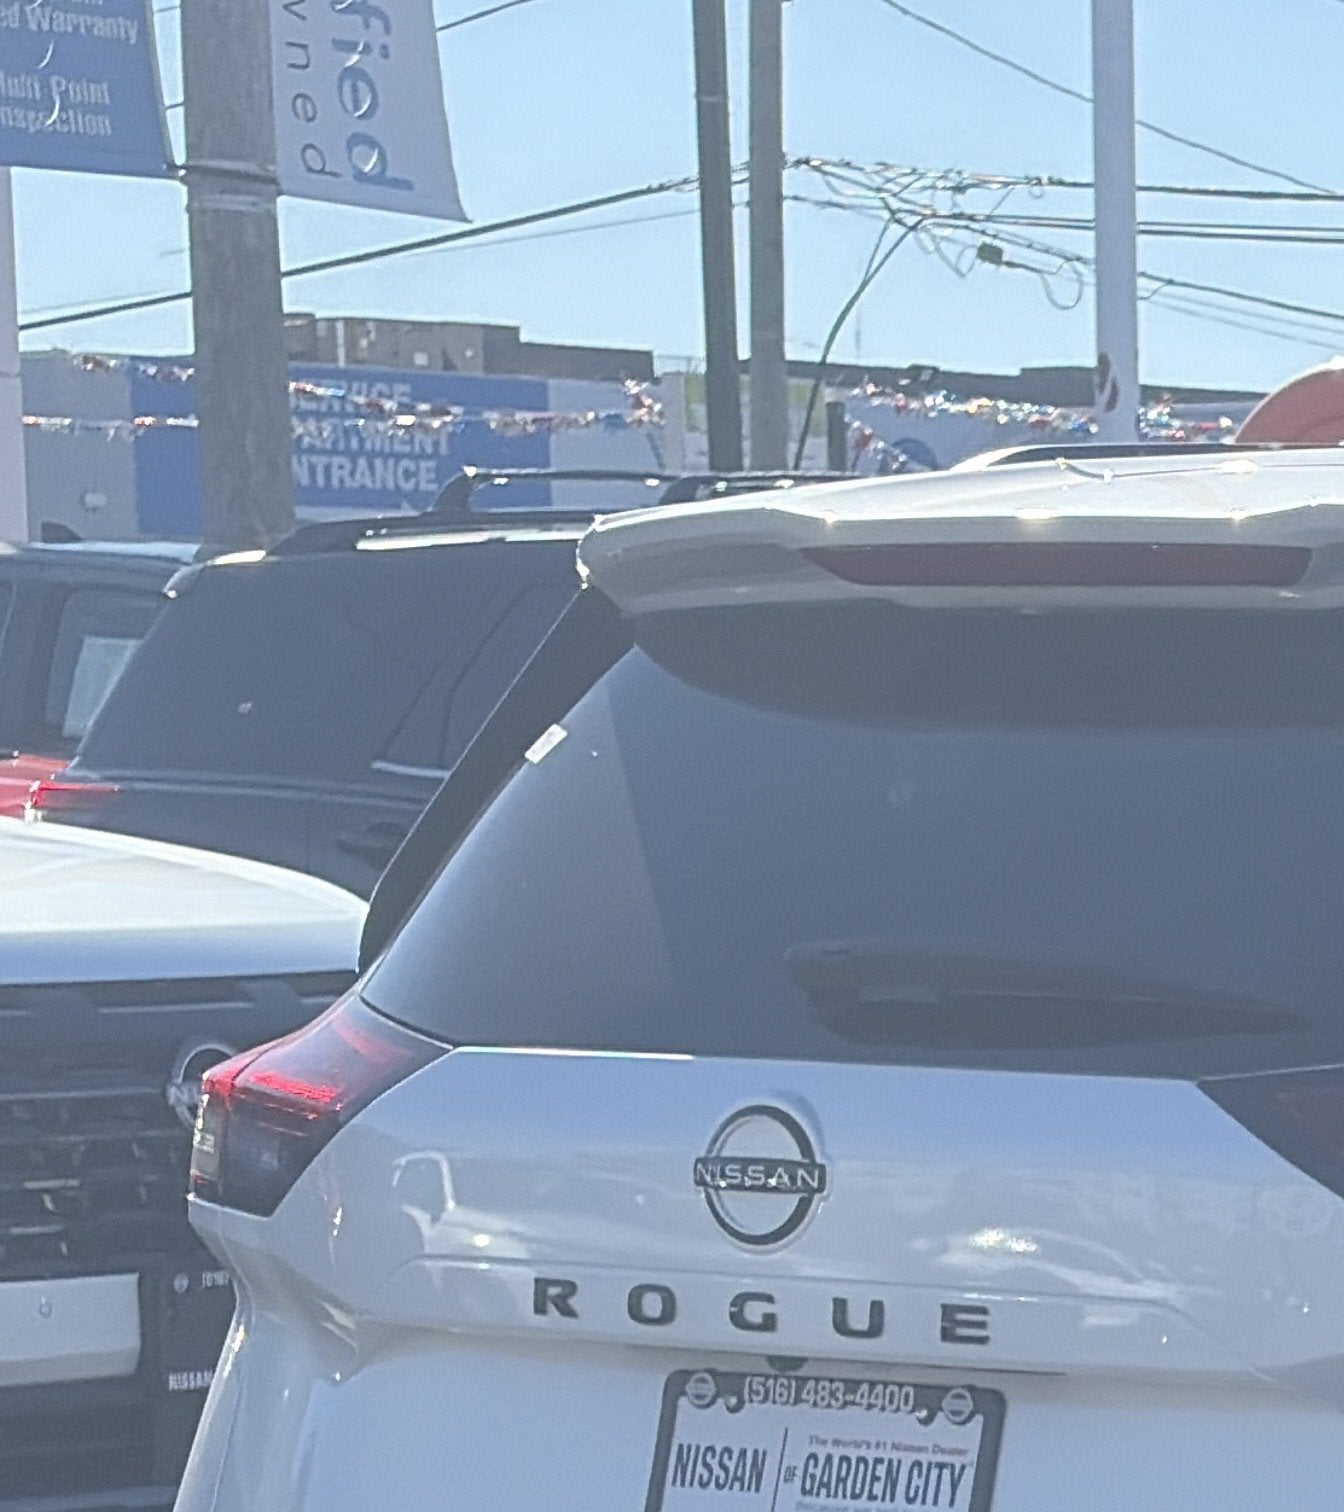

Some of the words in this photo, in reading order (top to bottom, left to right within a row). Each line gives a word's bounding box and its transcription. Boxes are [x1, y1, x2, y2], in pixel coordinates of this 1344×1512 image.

[26, 5, 139, 44] Warranty
[291, 454, 440, 491] NTRANCE
[695, 1162, 820, 1190] NISSAN
[533, 1276, 991, 1346] ROGUE
[743, 1375, 796, 1404] (516)
[801, 1379, 914, 1412] 483-4400
[671, 1443, 768, 1493] NISSAN
[800, 1452, 902, 1504] GARDEN
[904, 1459, 967, 1508] CITY
